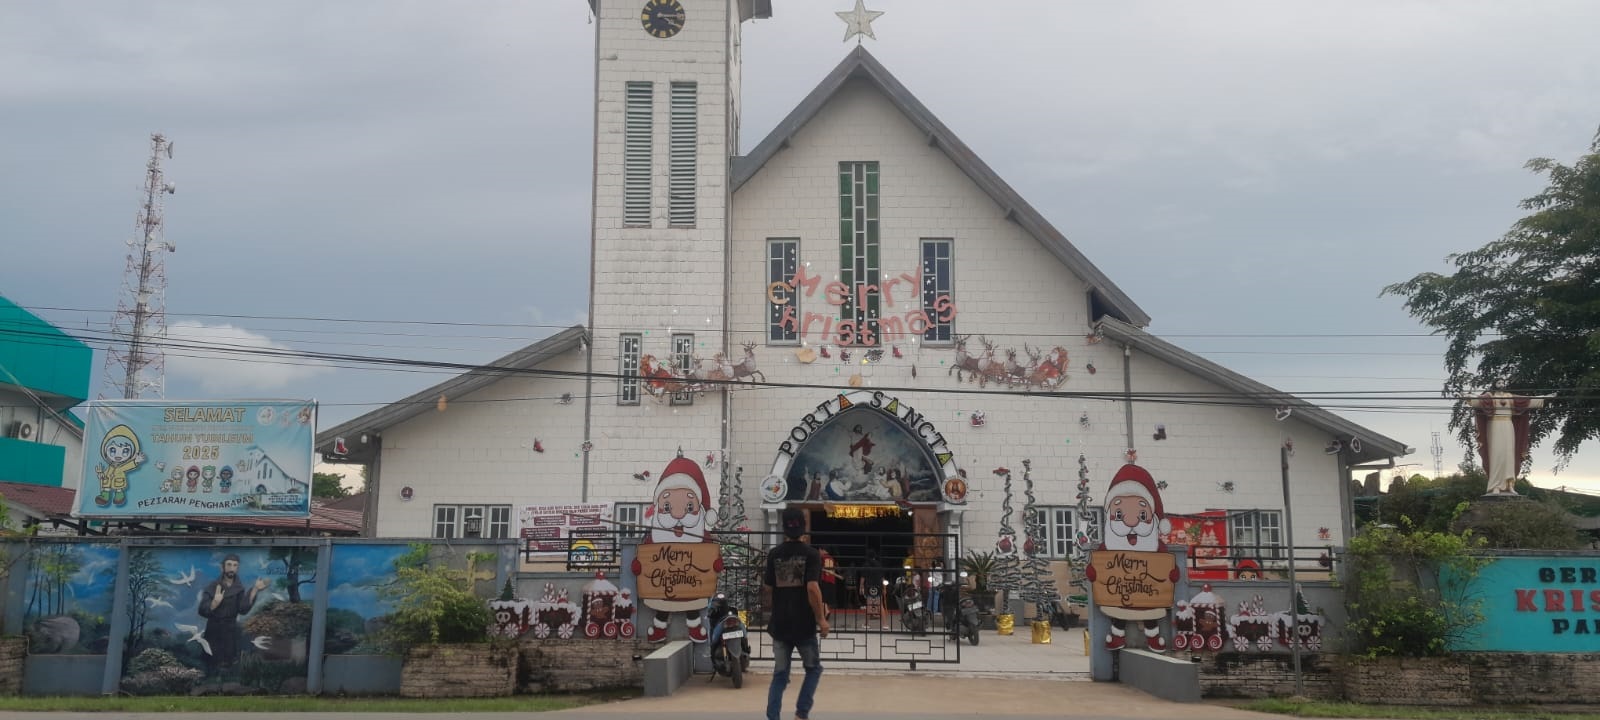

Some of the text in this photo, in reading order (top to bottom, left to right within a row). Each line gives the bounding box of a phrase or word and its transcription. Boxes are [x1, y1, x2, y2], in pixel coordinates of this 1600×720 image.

[789, 264, 922, 312] Merry
[163, 407, 246, 423] SELAMAT
[151, 433, 193, 444] TAHUN
[778, 391, 953, 468] PORTA SANCTA
[182, 445, 220, 460] 2025
[137, 495, 187, 509] PEZIARAH
[650, 545, 711, 573] Merry
[1105, 553, 1168, 583] Merry
[644, 568, 702, 599] Christmas
[1538, 567, 1598, 584] GER
[1103, 575, 1160, 606] Christmas
